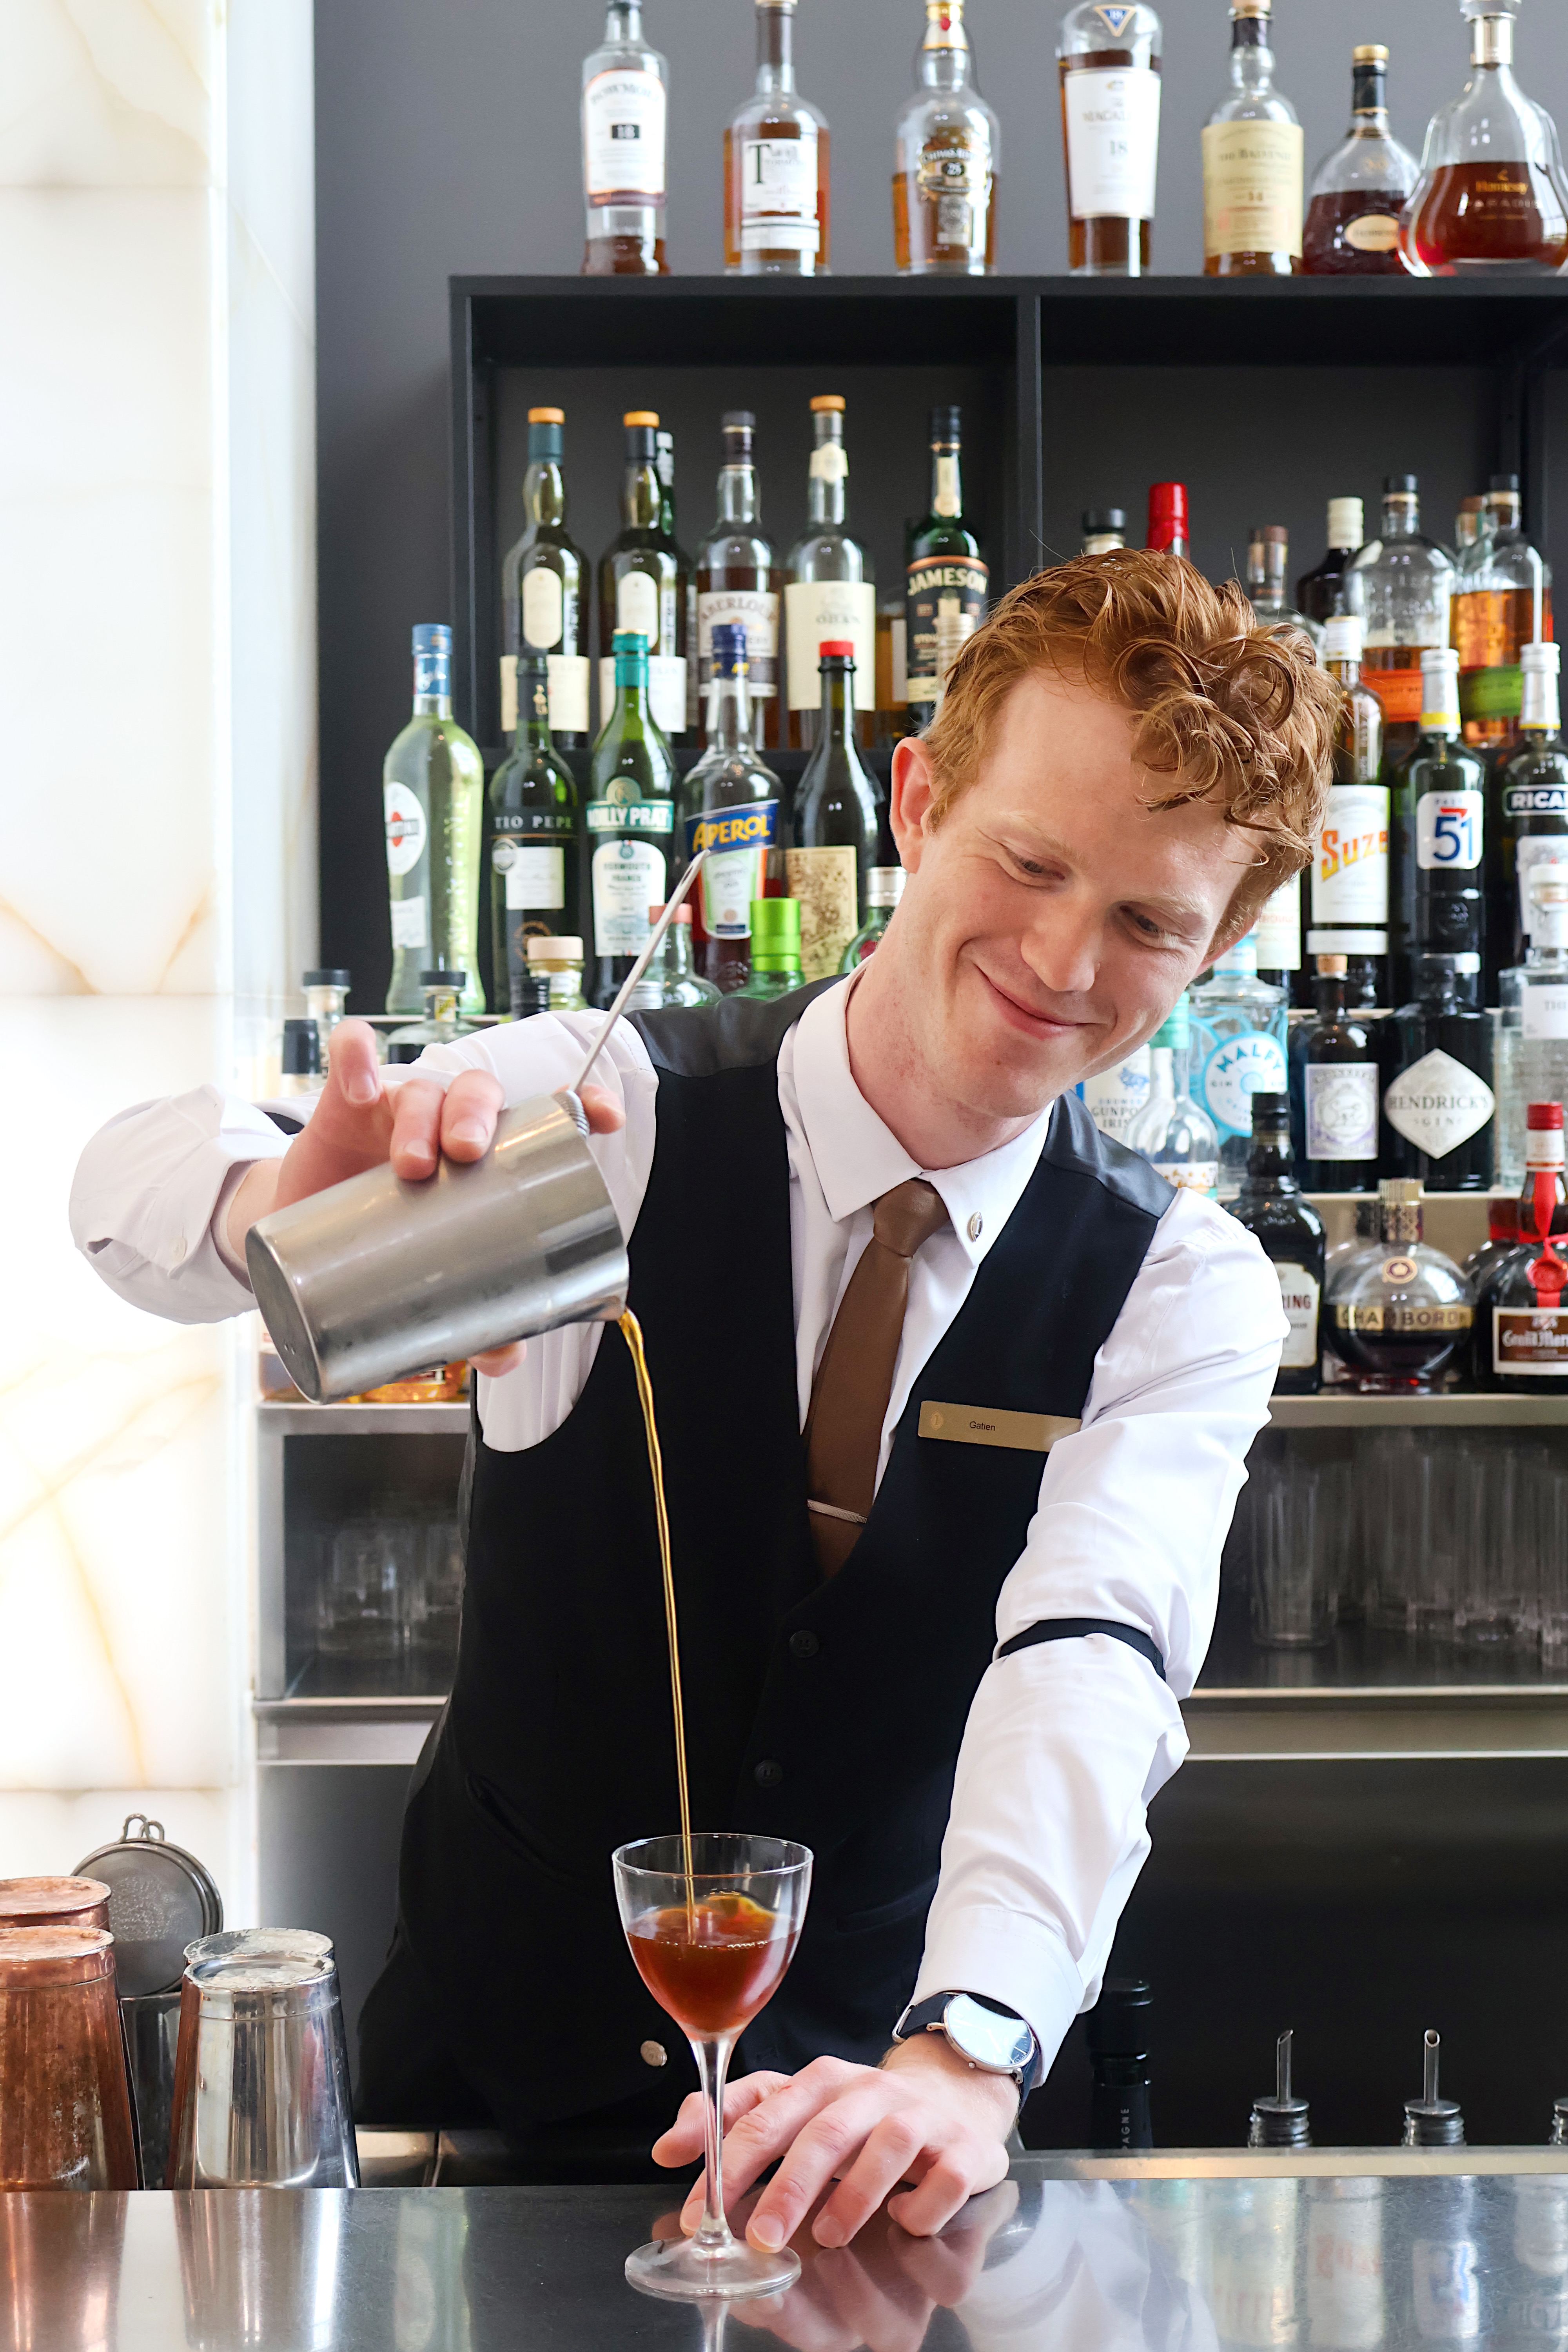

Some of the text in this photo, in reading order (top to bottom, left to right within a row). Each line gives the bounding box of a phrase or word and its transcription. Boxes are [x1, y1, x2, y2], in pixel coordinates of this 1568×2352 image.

[907, 567, 987, 595] JAMESON
[1511, 791, 1568, 809] RICA
[494, 815, 572, 829] TIO PEPE
[629, 806, 669, 827] PRAT
[693, 814, 771, 853] APEROL
[1434, 817, 1472, 860] 51
[1321, 829, 1388, 882] Suze
[969, 1421, 995, 1431] Gatien
